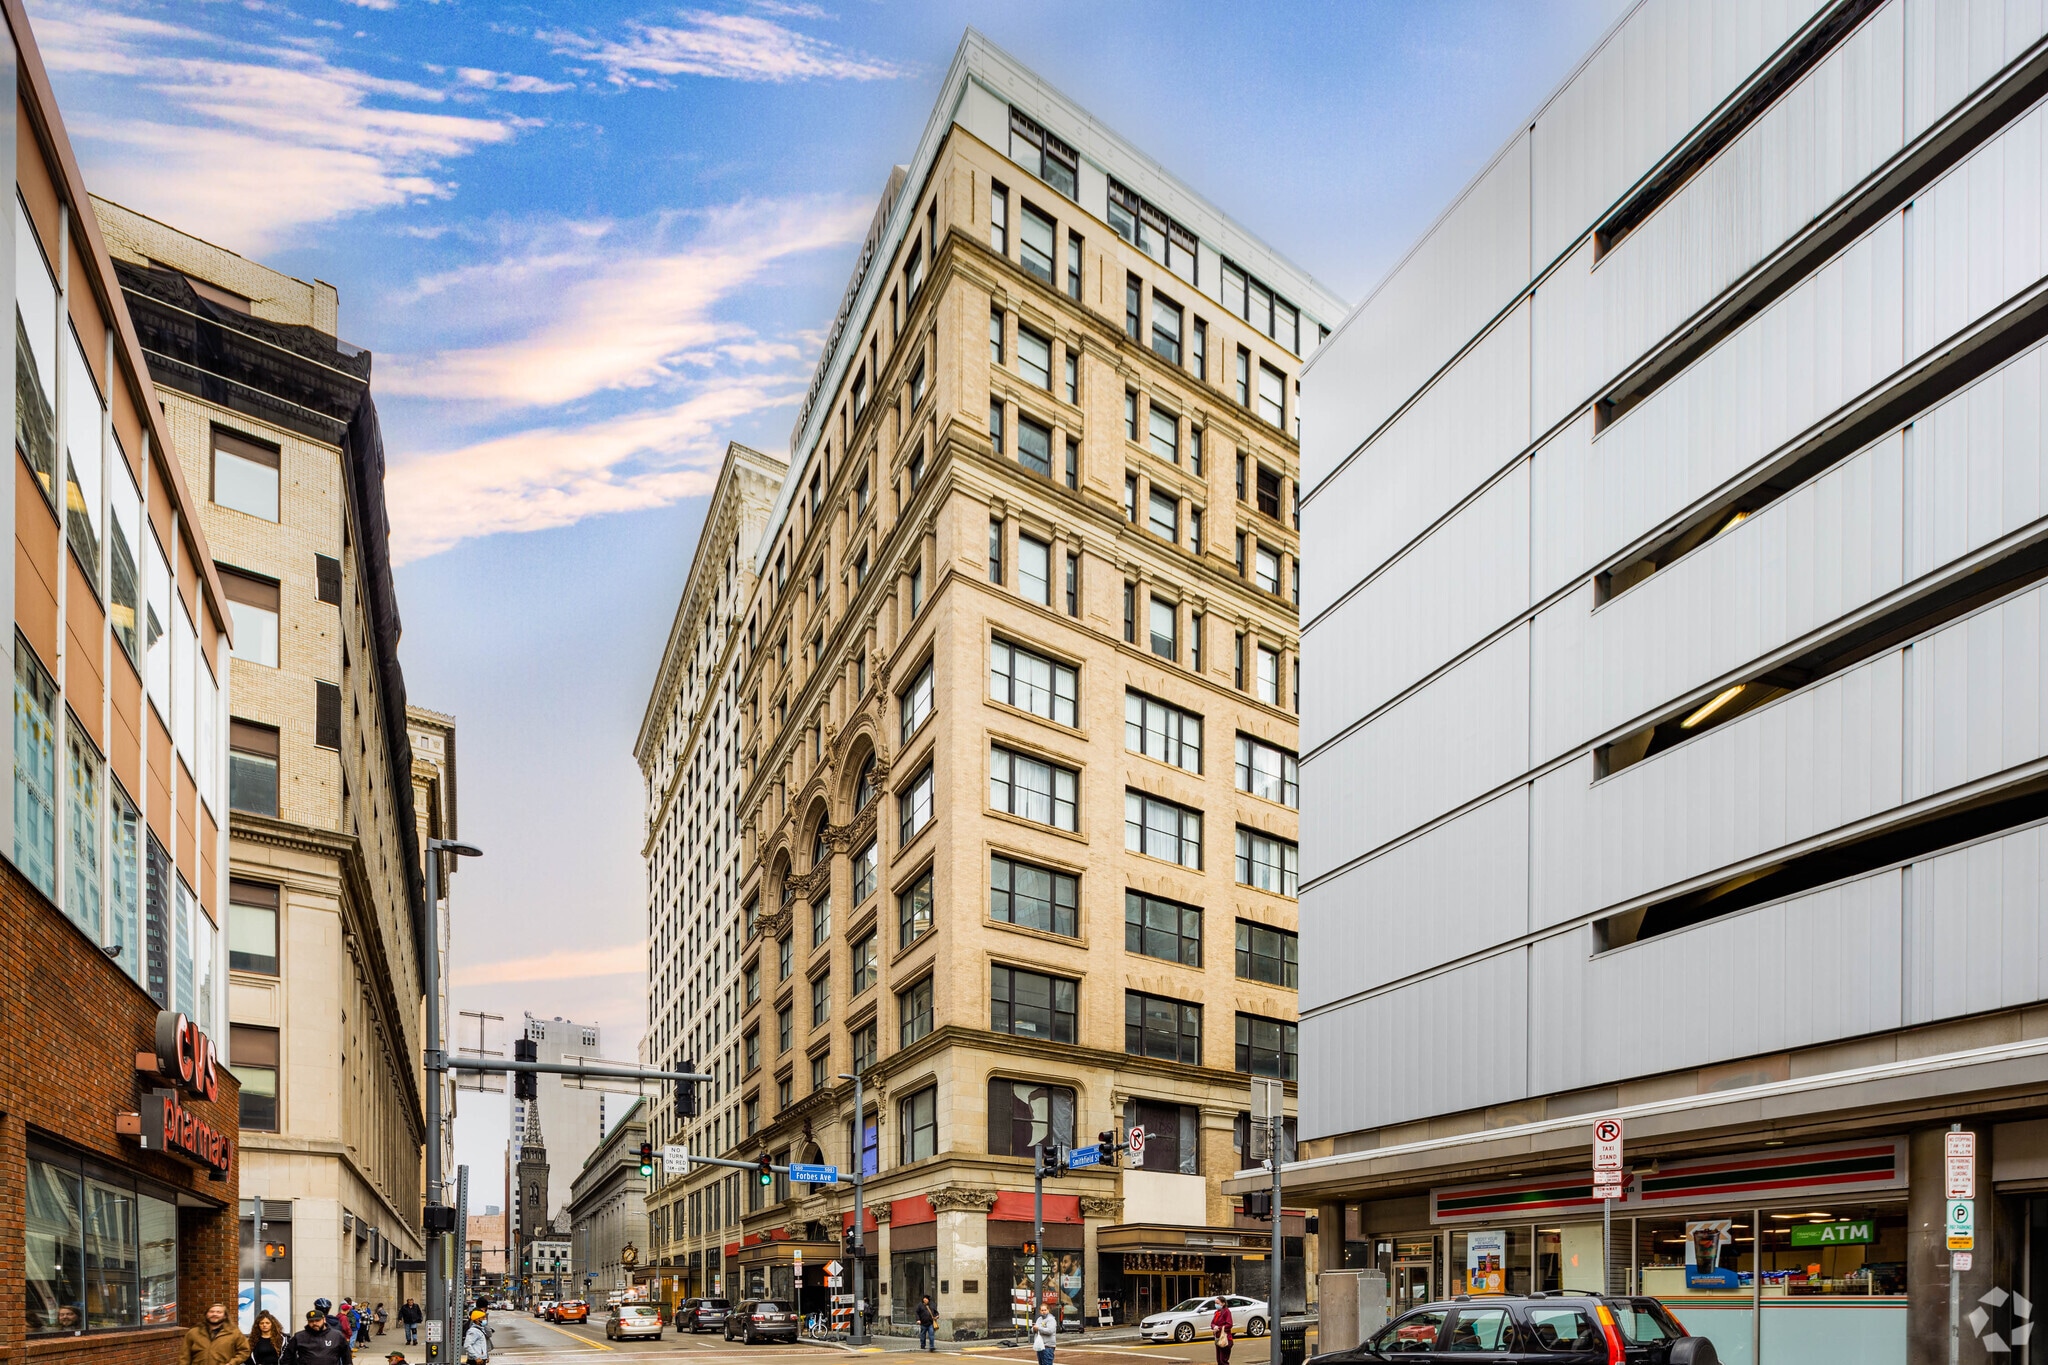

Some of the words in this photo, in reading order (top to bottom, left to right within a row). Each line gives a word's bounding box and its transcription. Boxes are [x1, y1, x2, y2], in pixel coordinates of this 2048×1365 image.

[174, 1011, 219, 1103] CVS
[163, 1087, 233, 1183] pharmacy
[1072, 1155, 1094, 1166] Smithfield
[796, 1172, 817, 1180] Forbes
[1821, 1225, 1868, 1241] ATM
[279, 1246, 284, 1257] 9
